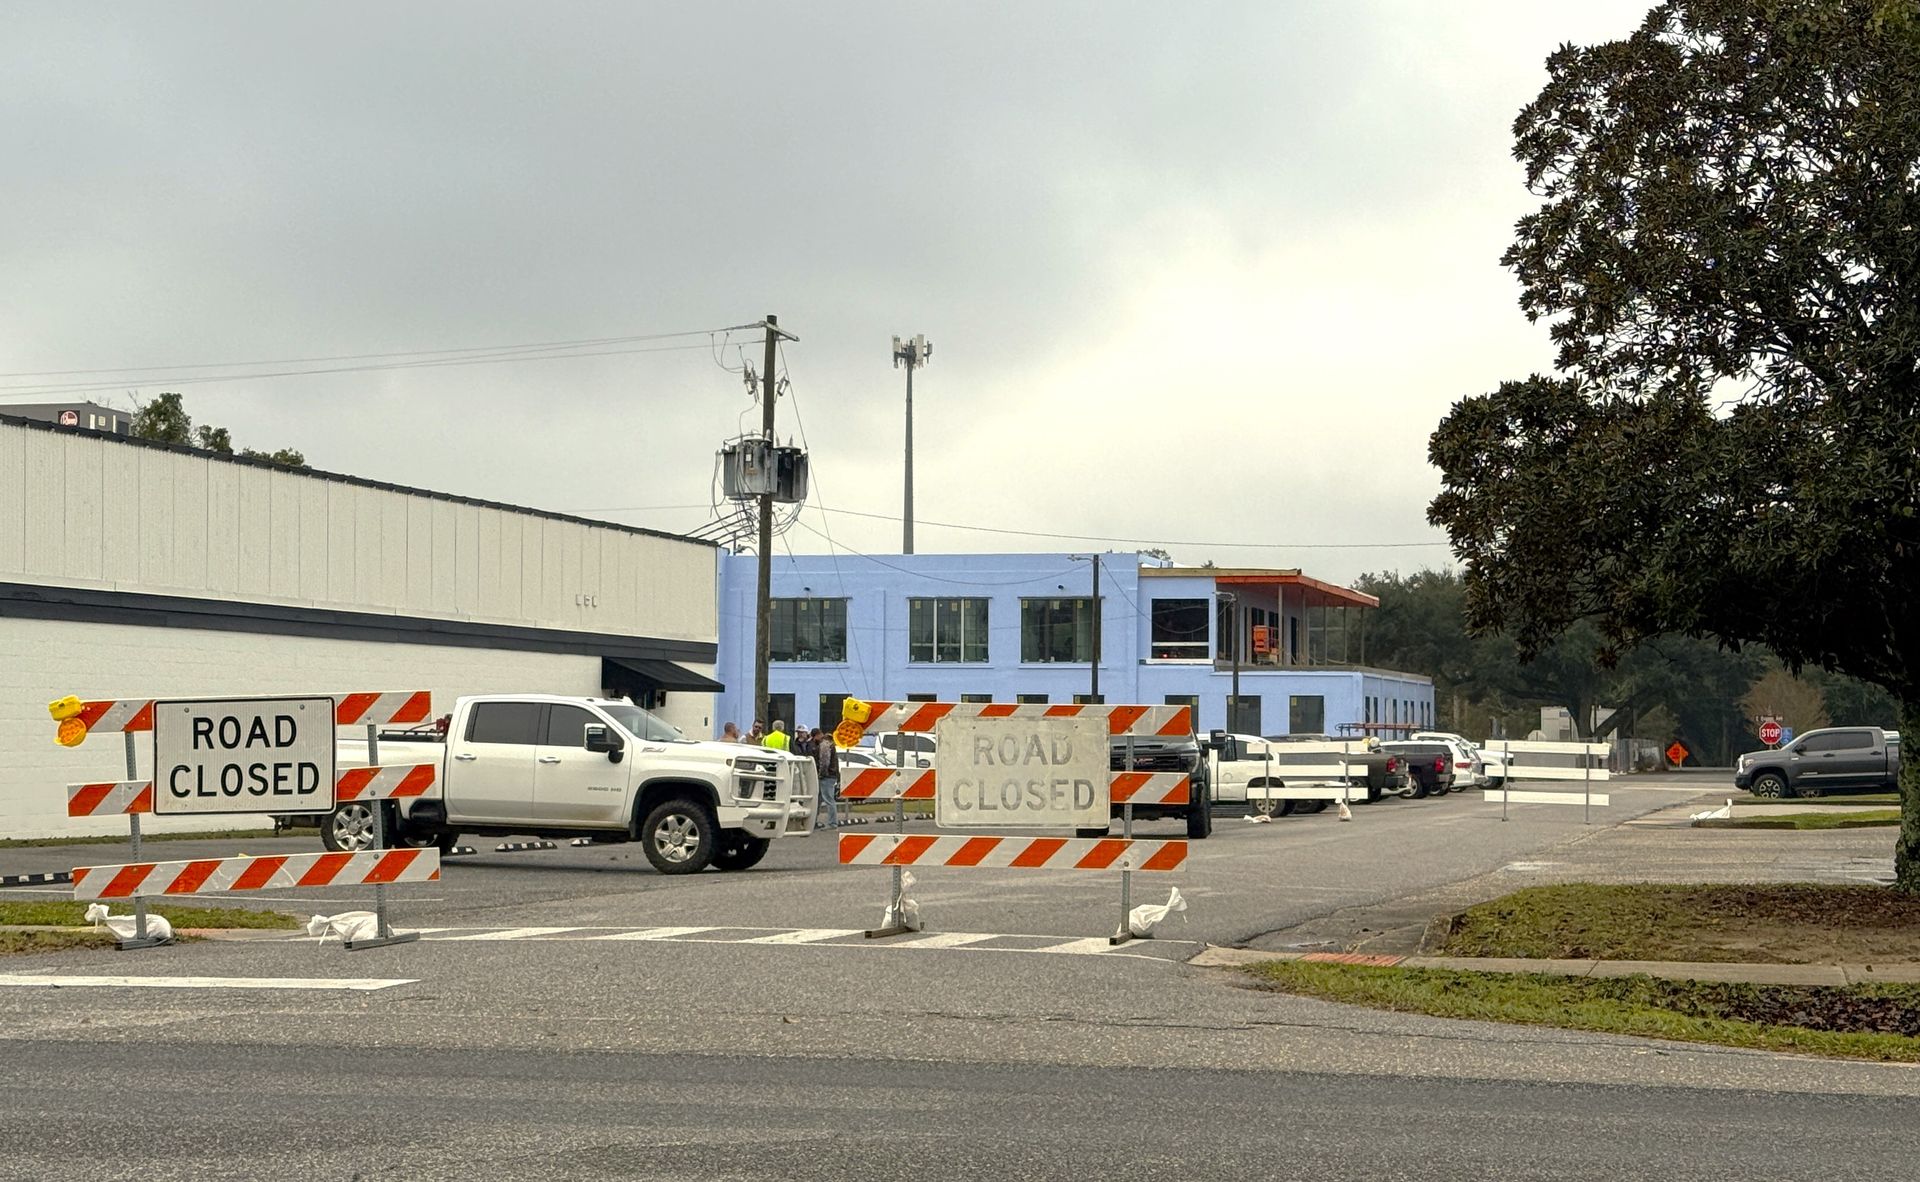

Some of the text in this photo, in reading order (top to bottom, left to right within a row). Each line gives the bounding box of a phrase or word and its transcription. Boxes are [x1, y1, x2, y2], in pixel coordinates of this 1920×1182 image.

[192, 715, 297, 750] ROAD
[1761, 728, 1780, 738] STOP
[973, 733, 1073, 766] ROAD
[169, 762, 320, 798] CLOSED
[952, 778, 1095, 811] CLOSED
